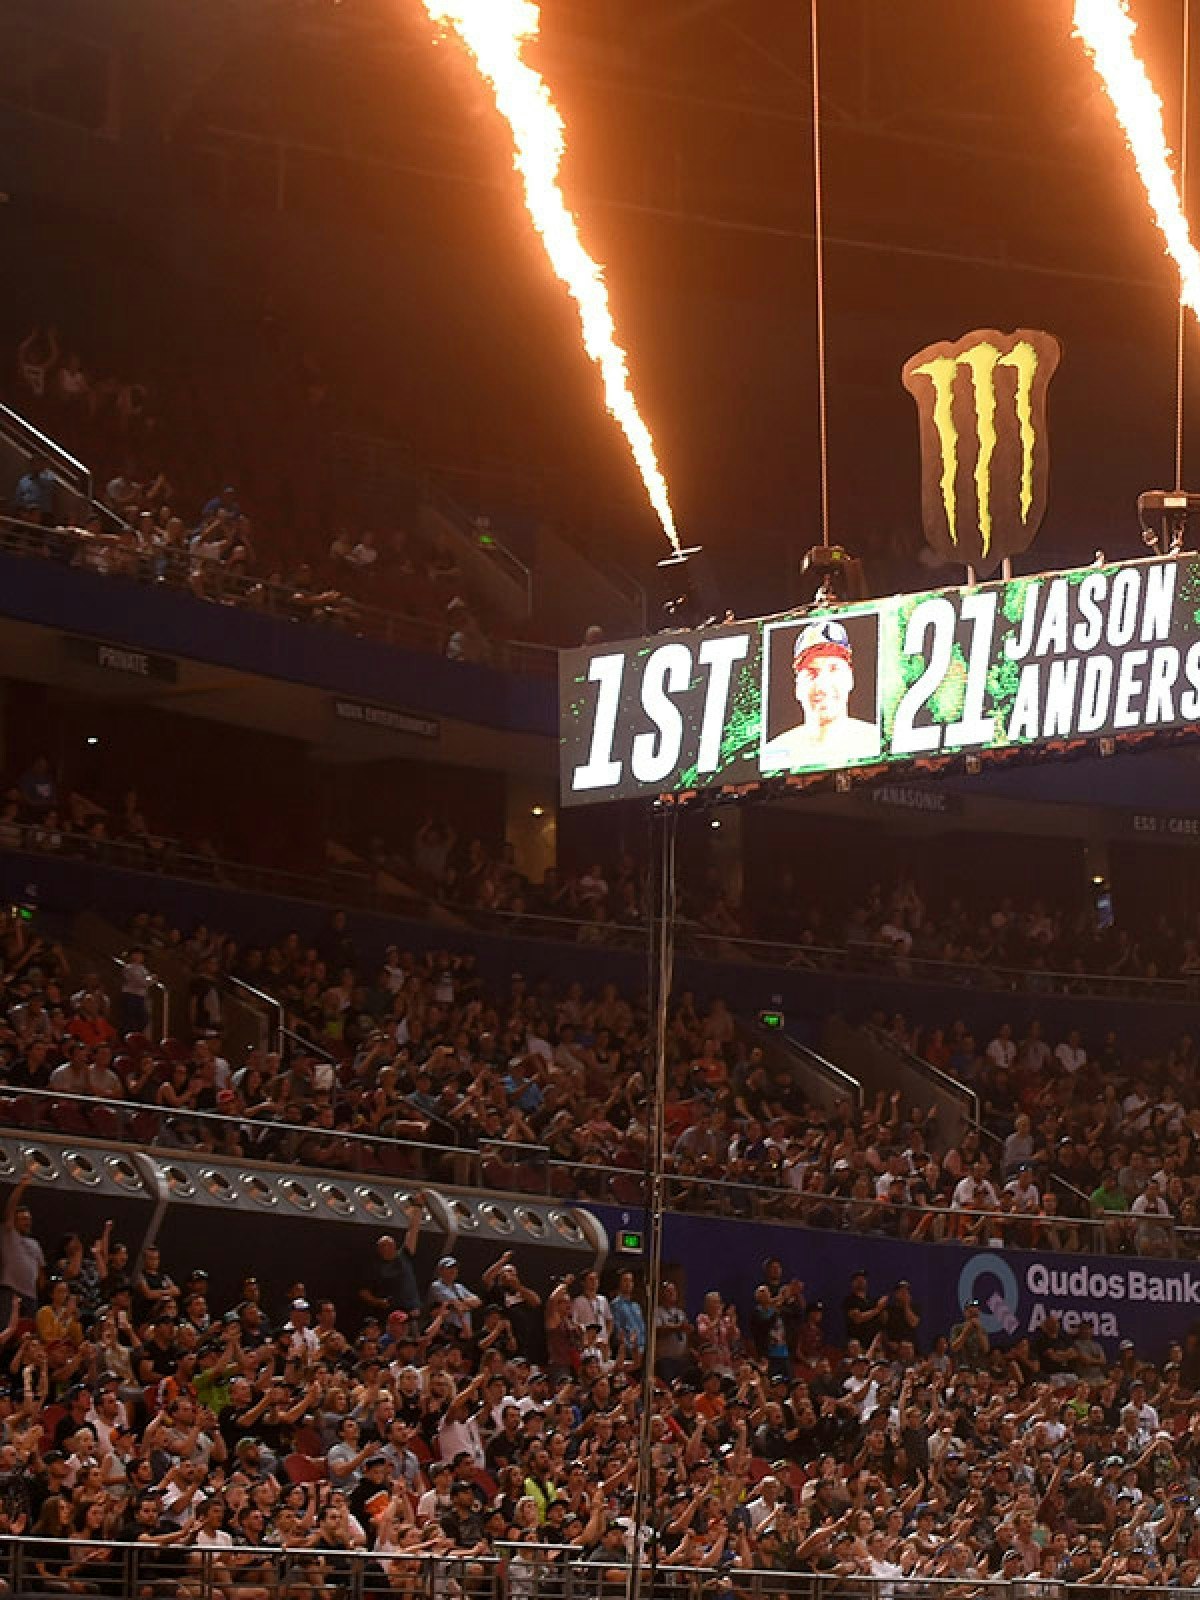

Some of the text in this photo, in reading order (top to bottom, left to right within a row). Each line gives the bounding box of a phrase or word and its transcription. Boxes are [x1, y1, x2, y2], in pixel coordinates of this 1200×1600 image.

[891, 591, 997, 754] 21
[1004, 563, 1177, 661] JASON
[571, 635, 750, 790] 1ST
[1025, 1262, 1125, 1299] Qudos
